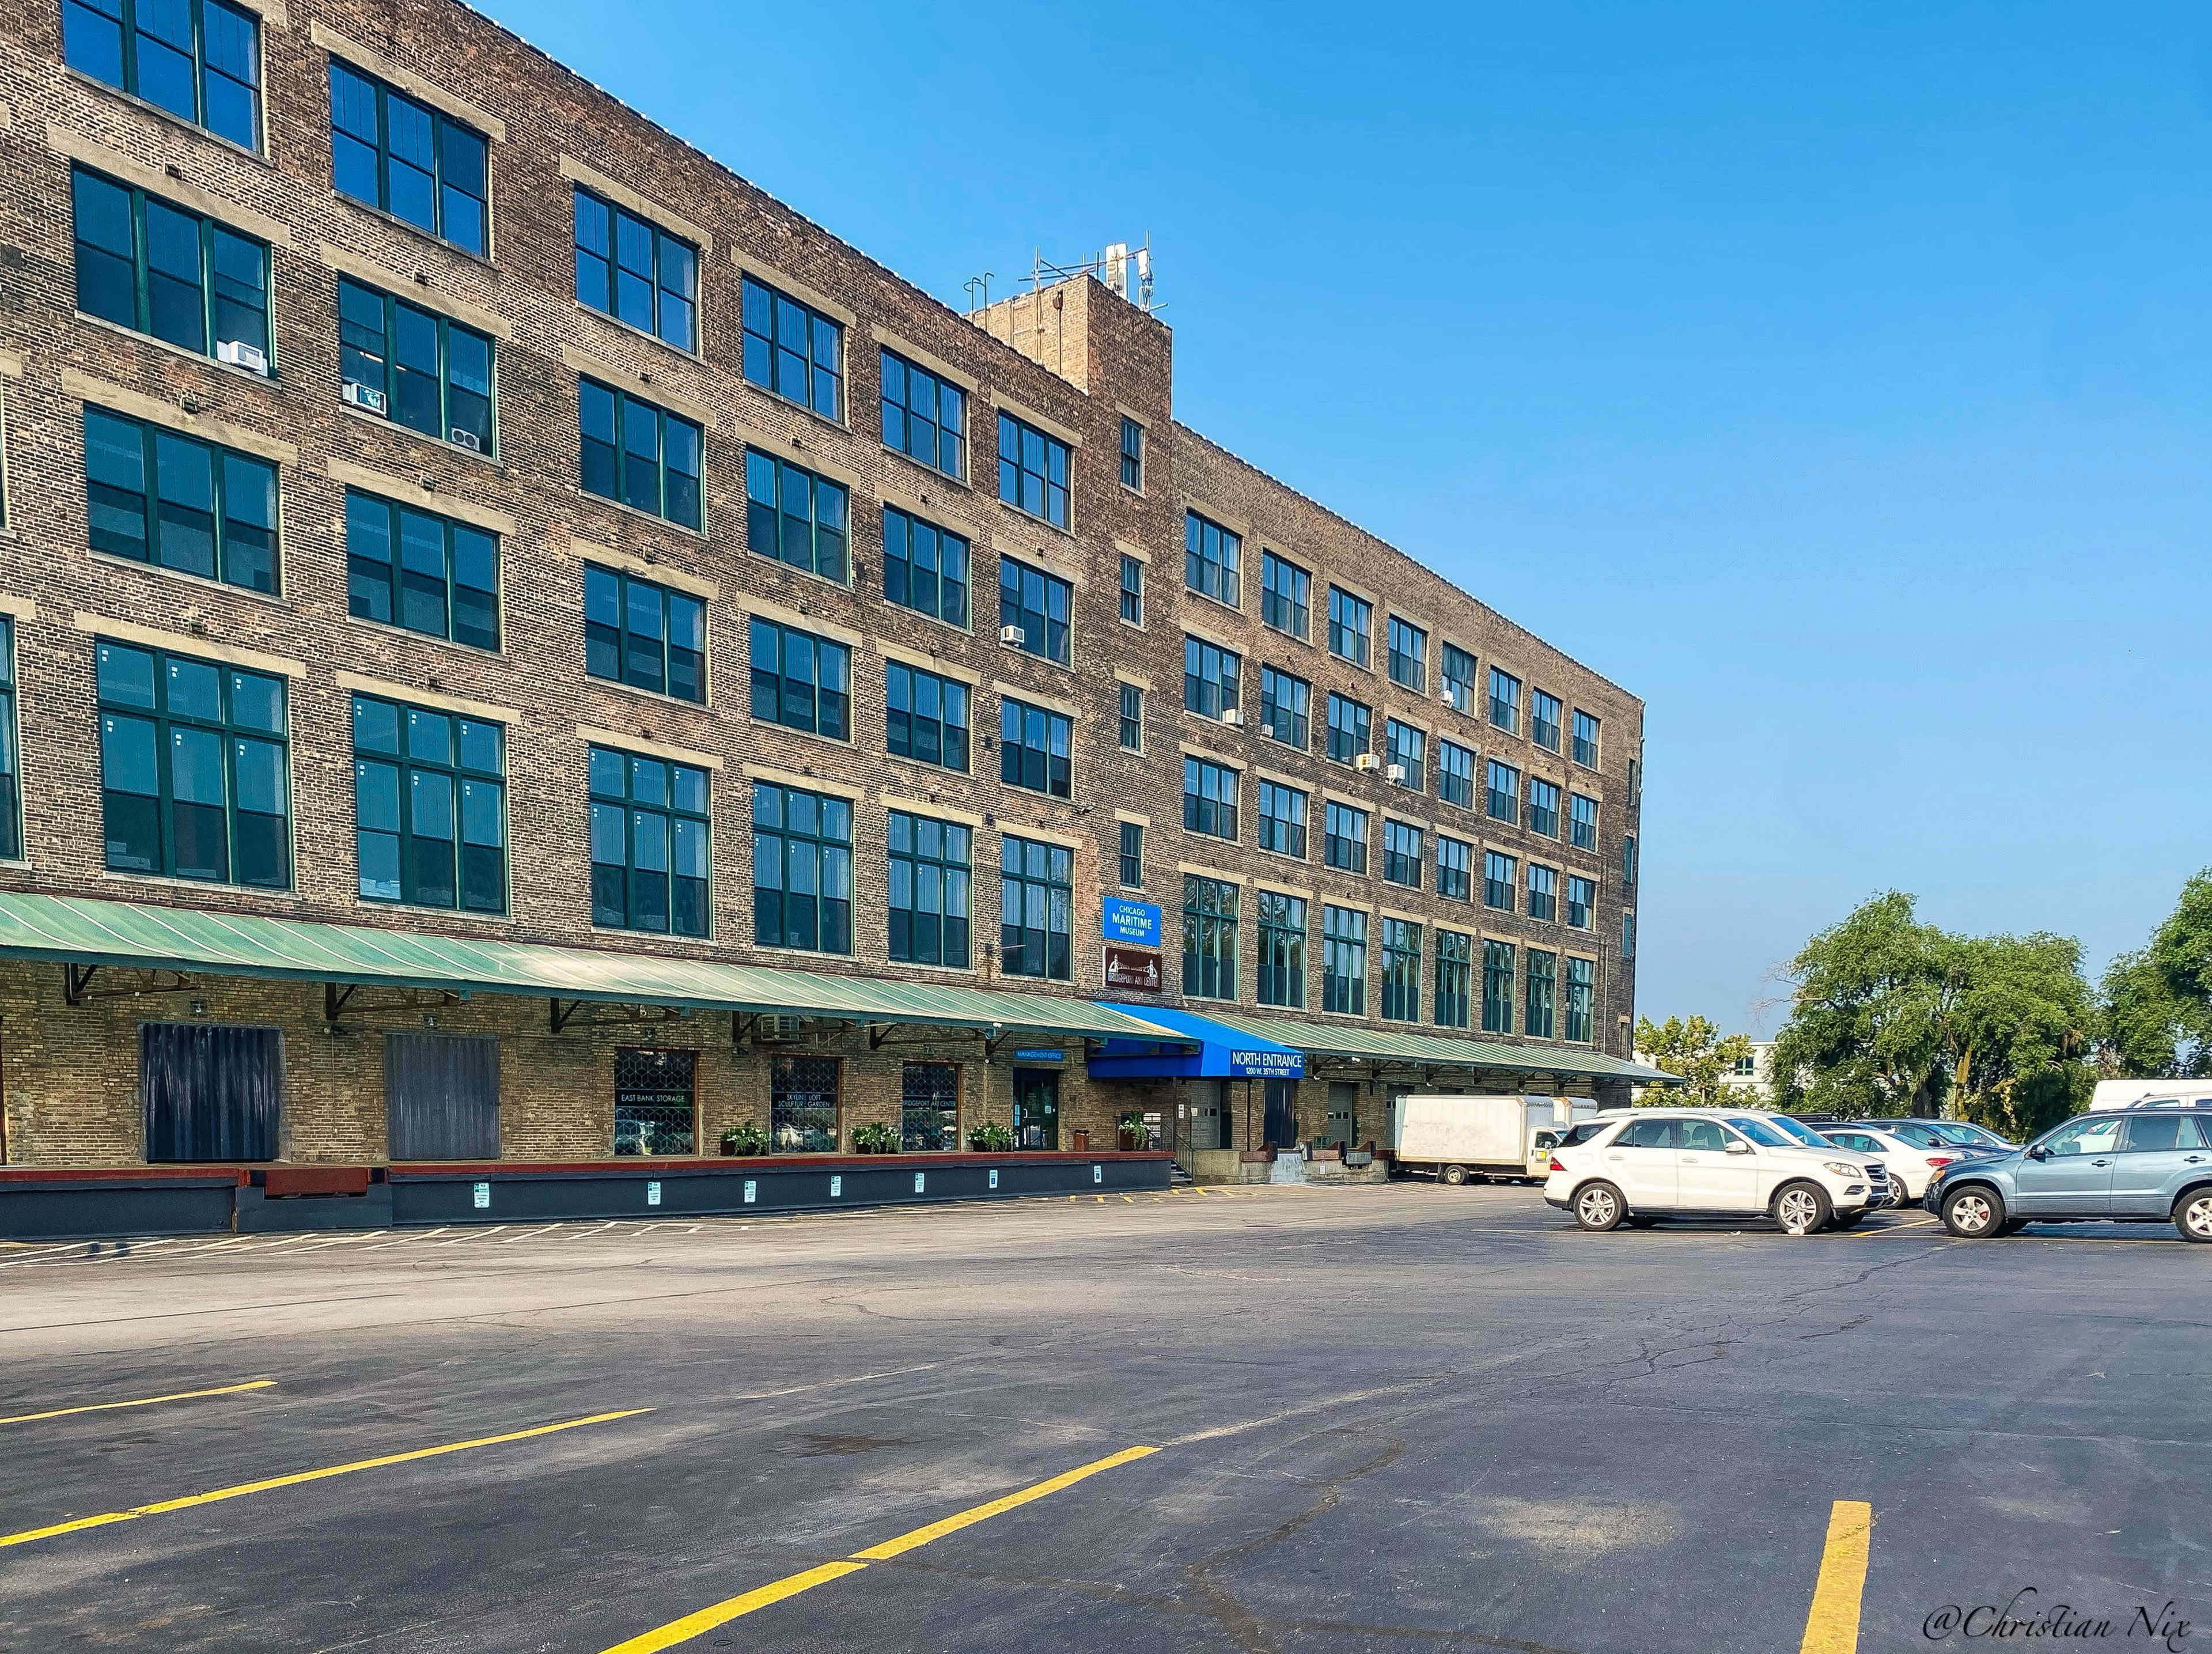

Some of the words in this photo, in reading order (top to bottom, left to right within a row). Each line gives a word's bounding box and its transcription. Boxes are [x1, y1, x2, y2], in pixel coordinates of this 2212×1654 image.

[1119, 905, 1145, 916] CHICAGO
[1112, 913, 1152, 929] MARITIME
[1120, 926, 1145, 937] MUSEUM
[1108, 972, 1134, 984] BRIDGEPORT
[1135, 976, 1143, 985] ART
[1232, 1051, 1260, 1065] NORTH
[1263, 1053, 1302, 1068] ENTRANCE
